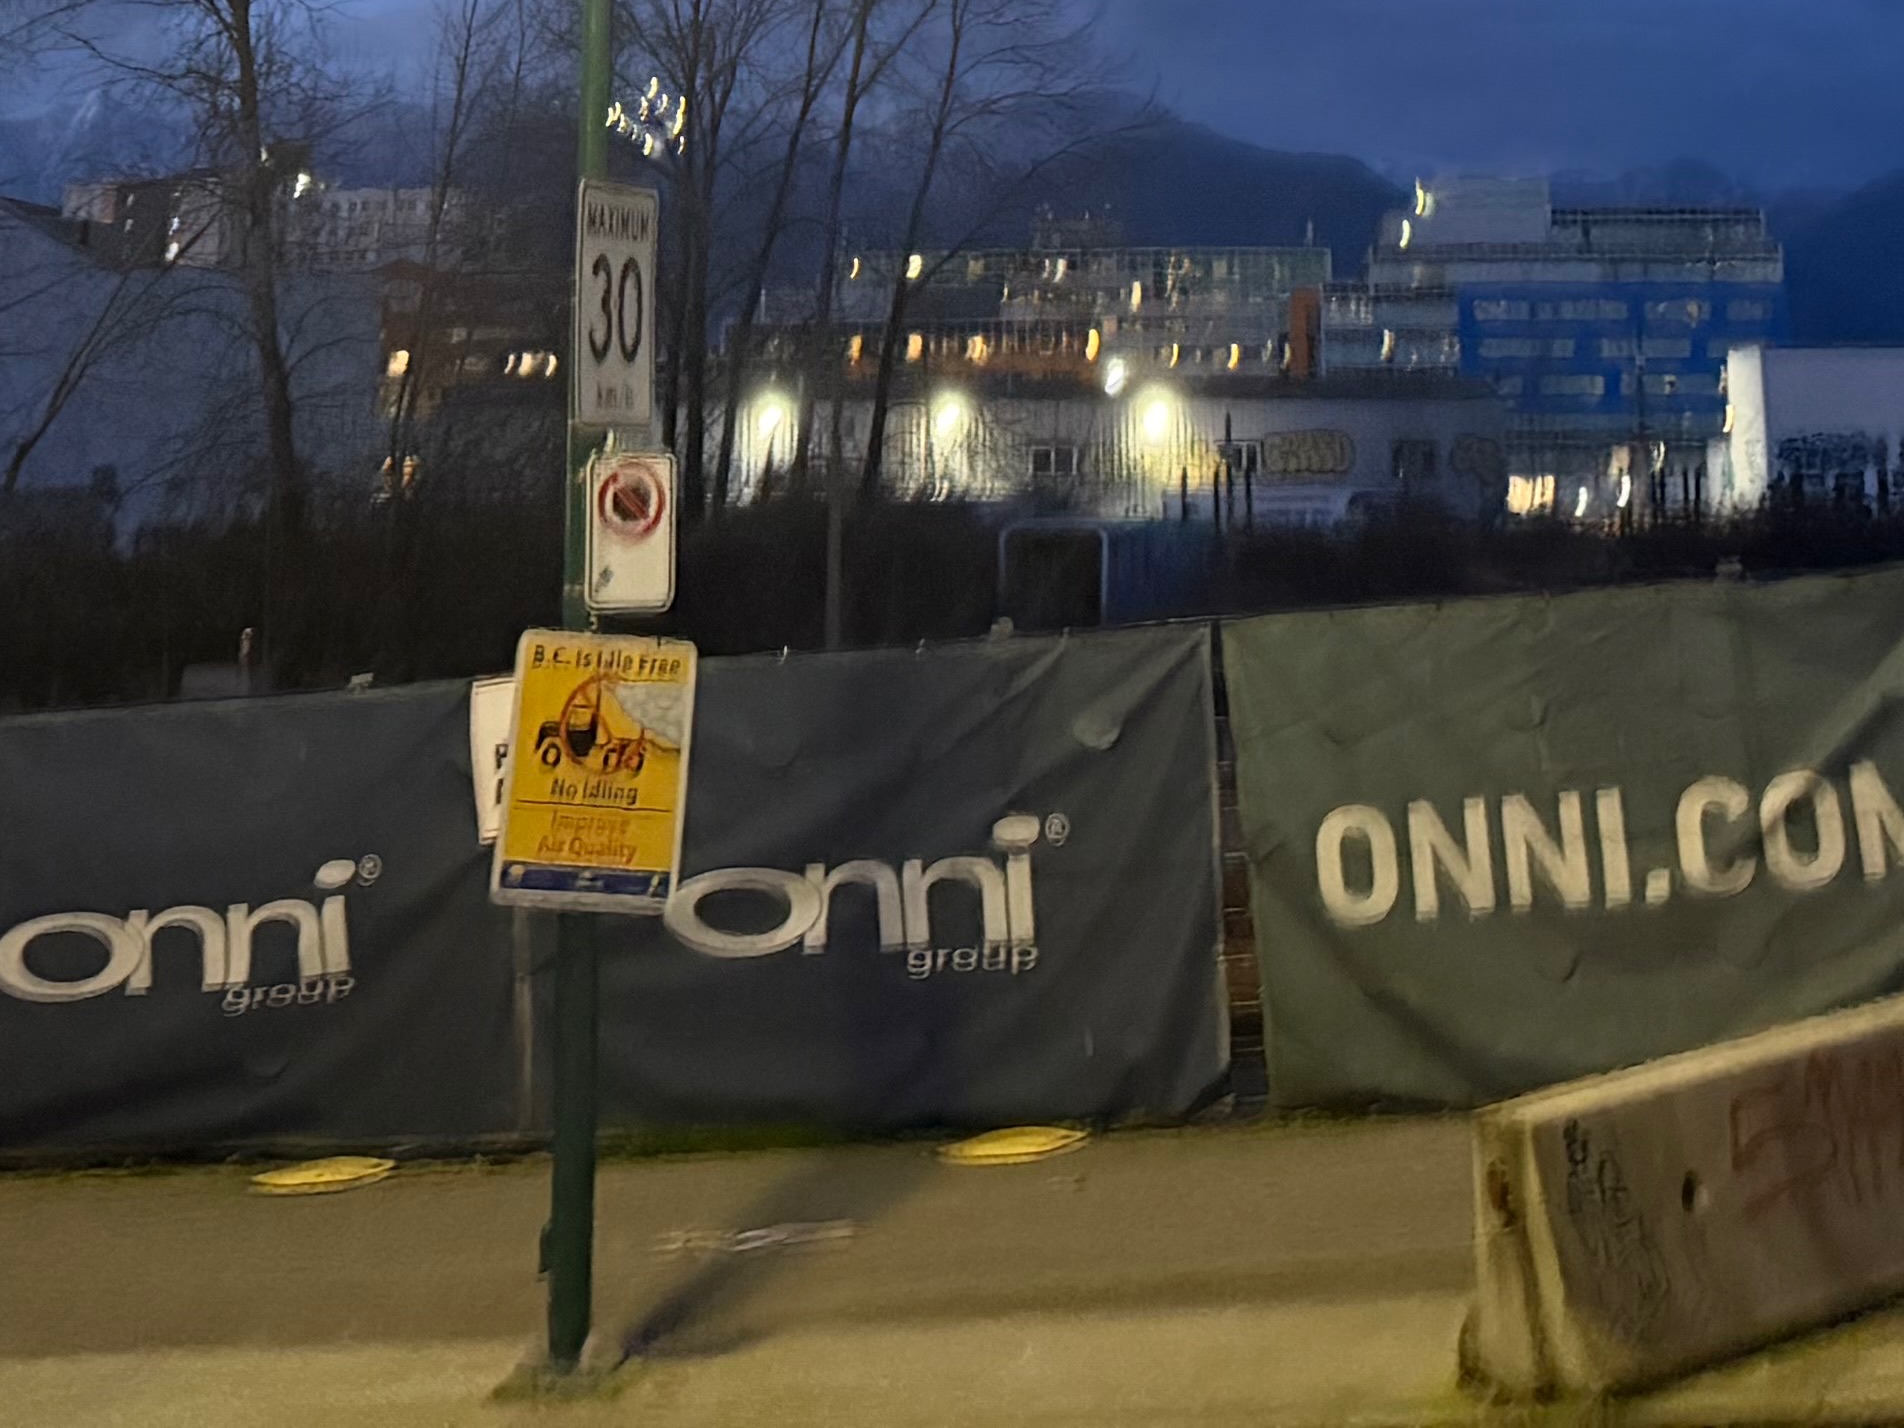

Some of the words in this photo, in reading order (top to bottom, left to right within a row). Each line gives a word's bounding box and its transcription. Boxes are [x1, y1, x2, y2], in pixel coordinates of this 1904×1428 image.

[587, 201, 649, 241] MAXIMUM
[589, 253, 642, 364] 30
[575, 650, 592, 668] Is
[598, 649, 633, 673] Idle
[638, 654, 681, 675] Free
[551, 778, 577, 799] No
[582, 780, 639, 805] Idling
[551, 811, 631, 836] Improve
[538, 835, 565, 857] Air
[568, 838, 638, 865] Quality
[663, 815, 1039, 958] onni
[907, 945, 1039, 980] group
[221, 976, 355, 1018] group
